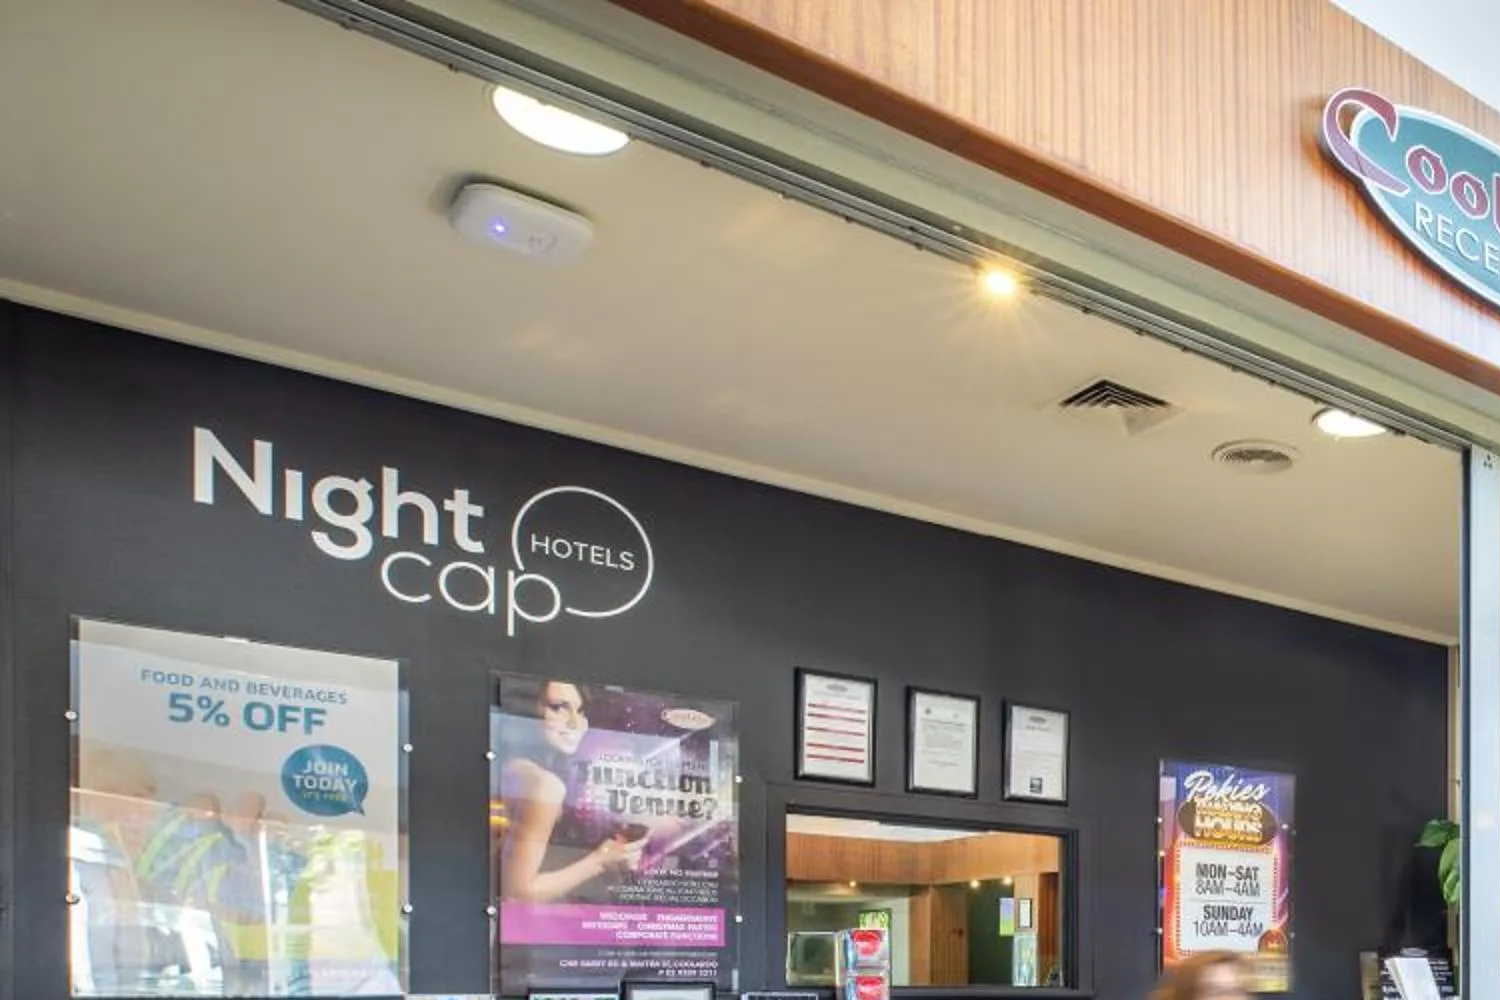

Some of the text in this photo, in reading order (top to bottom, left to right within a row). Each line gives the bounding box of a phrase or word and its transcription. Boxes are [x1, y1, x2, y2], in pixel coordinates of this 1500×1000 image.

[194, 426, 485, 561] Night
[530, 533, 636, 572] HOTELS
[381, 551, 561, 637] cap
[141, 669, 348, 705] FOOD AND BEVERAGES
[168, 691, 328, 735] 5% OFF
[292, 759, 358, 793] JOIN TODAY
[1184, 770, 1271, 802] Pokies
[1195, 862, 1260, 882] MON-SAT
[1203, 904, 1254, 922] SUNDAY
